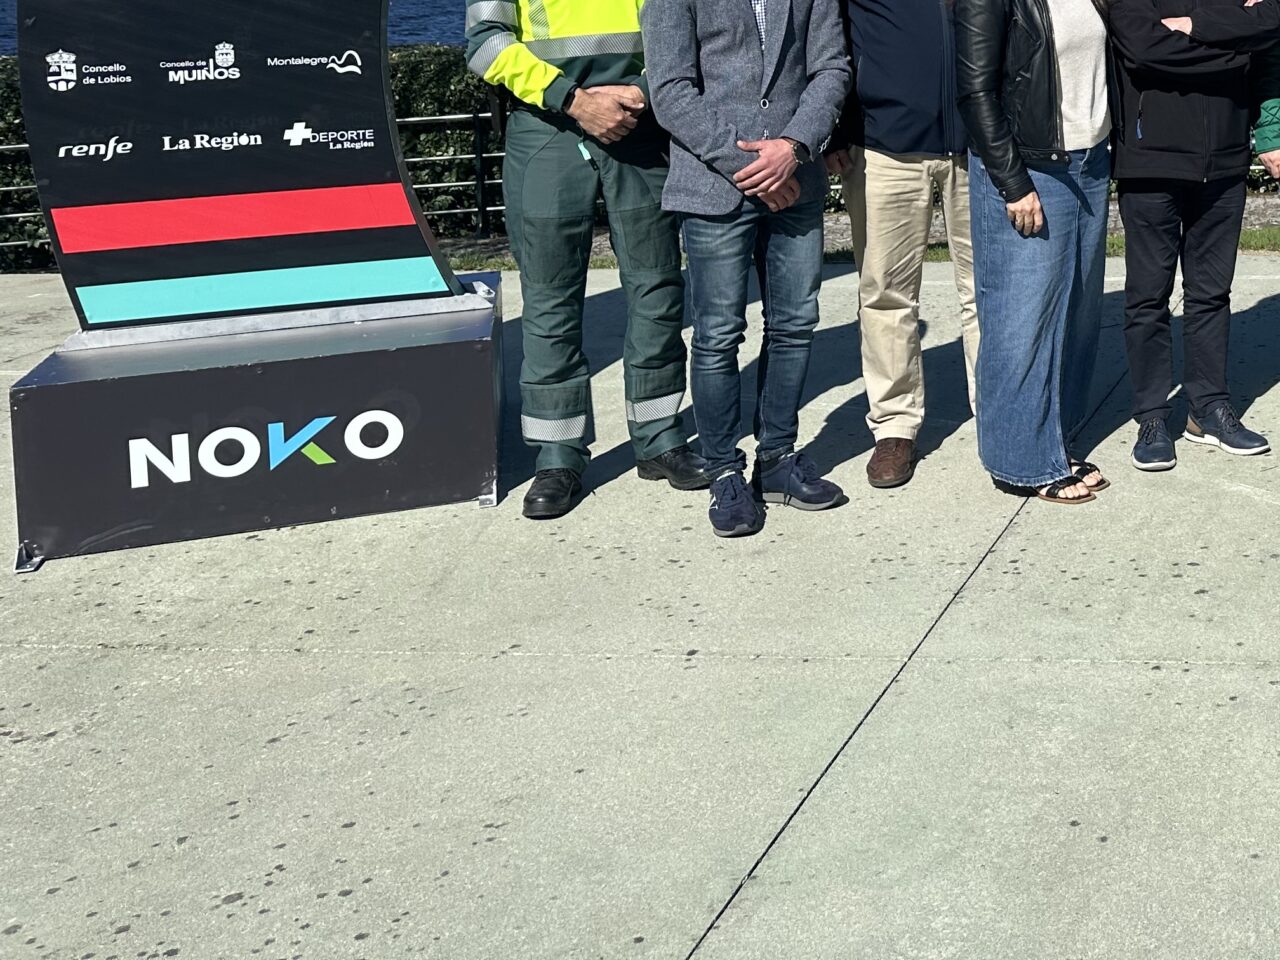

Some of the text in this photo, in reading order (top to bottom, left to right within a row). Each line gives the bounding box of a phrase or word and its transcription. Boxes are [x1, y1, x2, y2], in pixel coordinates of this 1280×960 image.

[159, 59, 207, 68] Concello de
[267, 56, 328, 67] Montalegre
[82, 64, 126, 72] Concello
[168, 58, 241, 84] MUIÑOS
[98, 75, 131, 83] Lobios
[163, 132, 262, 150] La Región
[310, 129, 374, 143] DEPORTE
[59, 136, 132, 161] renfe
[329, 142, 342, 150] La
[129, 410, 404, 489] NOKO
